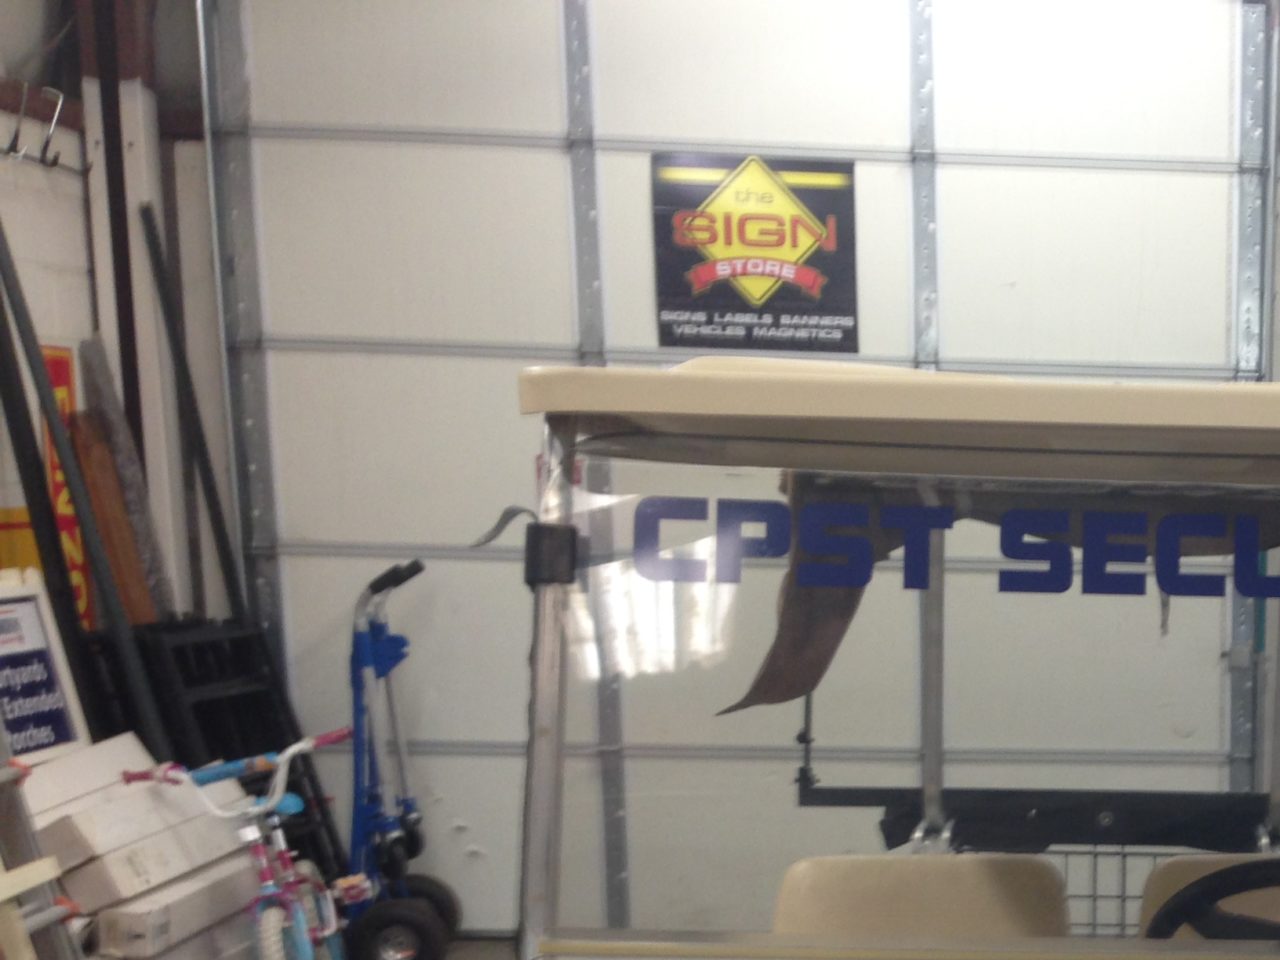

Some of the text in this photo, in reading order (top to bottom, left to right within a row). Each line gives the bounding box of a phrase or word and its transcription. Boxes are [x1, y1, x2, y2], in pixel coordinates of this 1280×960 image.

[735, 188, 774, 204] the
[673, 211, 837, 252] SIGN
[715, 257, 797, 280] STORE
[660, 309, 854, 327] SIGNS LABELS BANNERS
[672, 324, 843, 340] VEHICLES MAGNETICS
[633, 496, 956, 590] CPST
